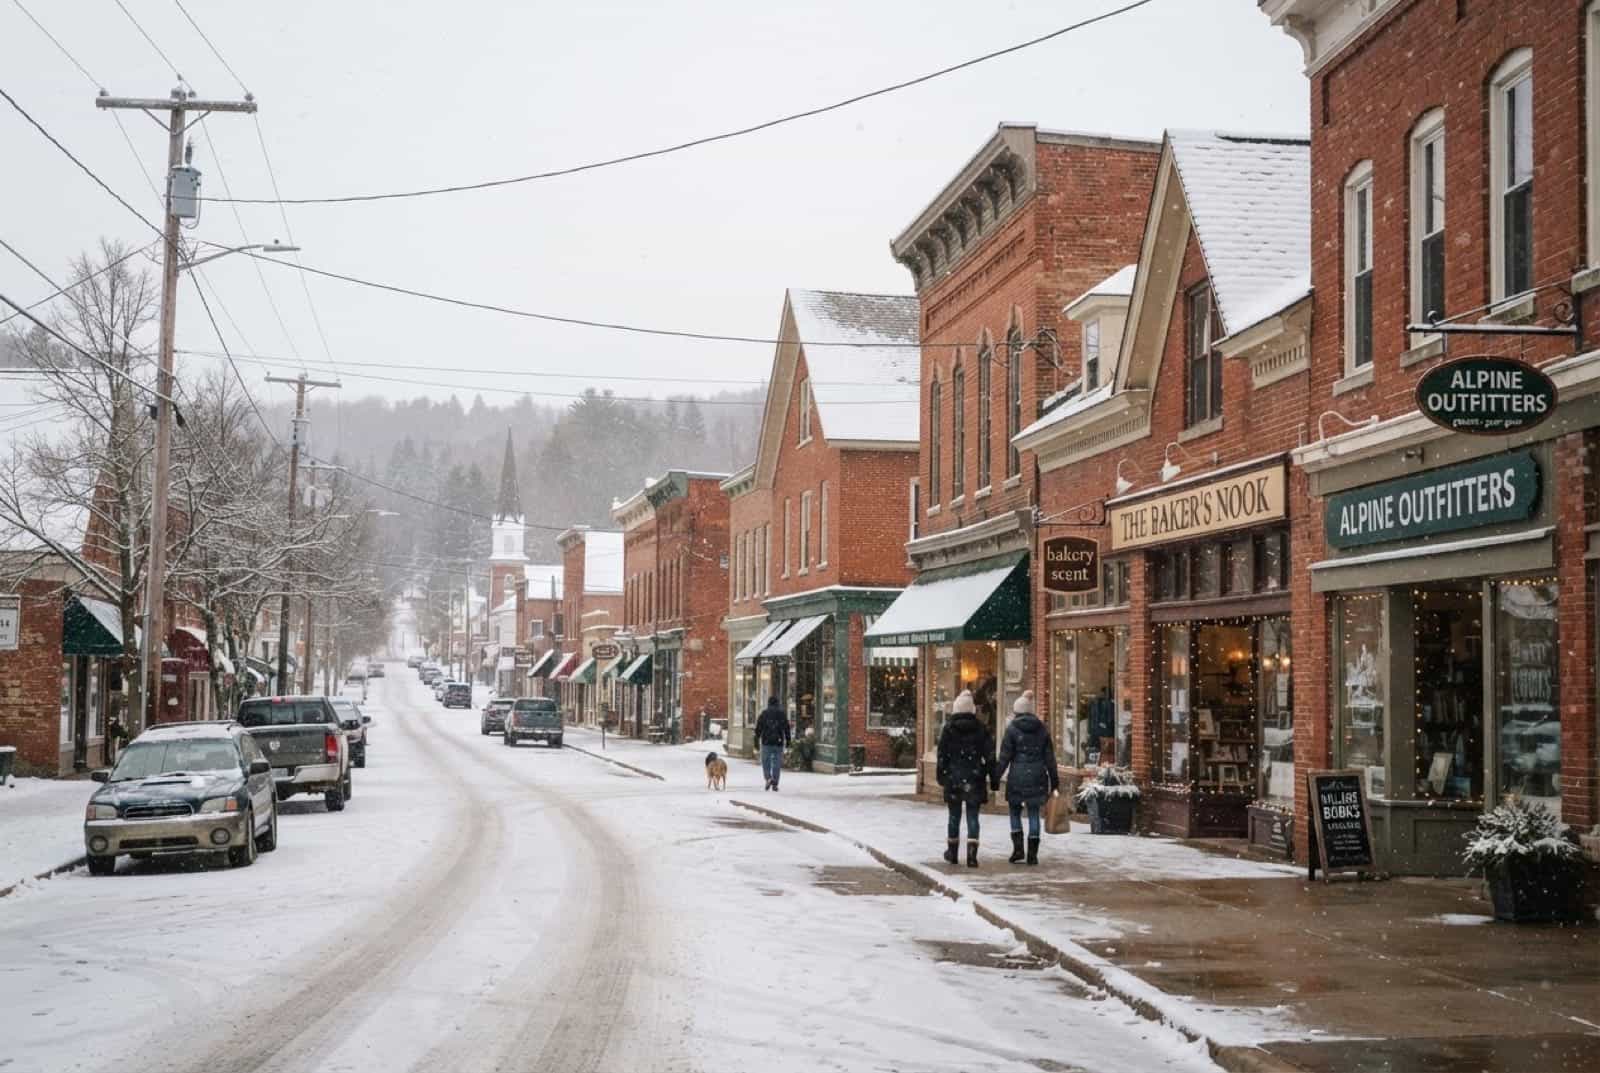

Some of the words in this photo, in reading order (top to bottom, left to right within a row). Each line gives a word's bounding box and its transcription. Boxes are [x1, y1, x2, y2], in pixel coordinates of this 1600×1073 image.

[1450, 370, 1523, 390] ALPINE
[1427, 393, 1547, 413] OUTFITTERS
[1120, 508, 1147, 541] THE
[1151, 491, 1212, 535] BAKER'S
[1216, 476, 1270, 521] NOOK
[1340, 496, 1394, 536] ALPINE
[1399, 468, 1515, 525] OUTFITTERS
[1051, 568, 1089, 581] scent
